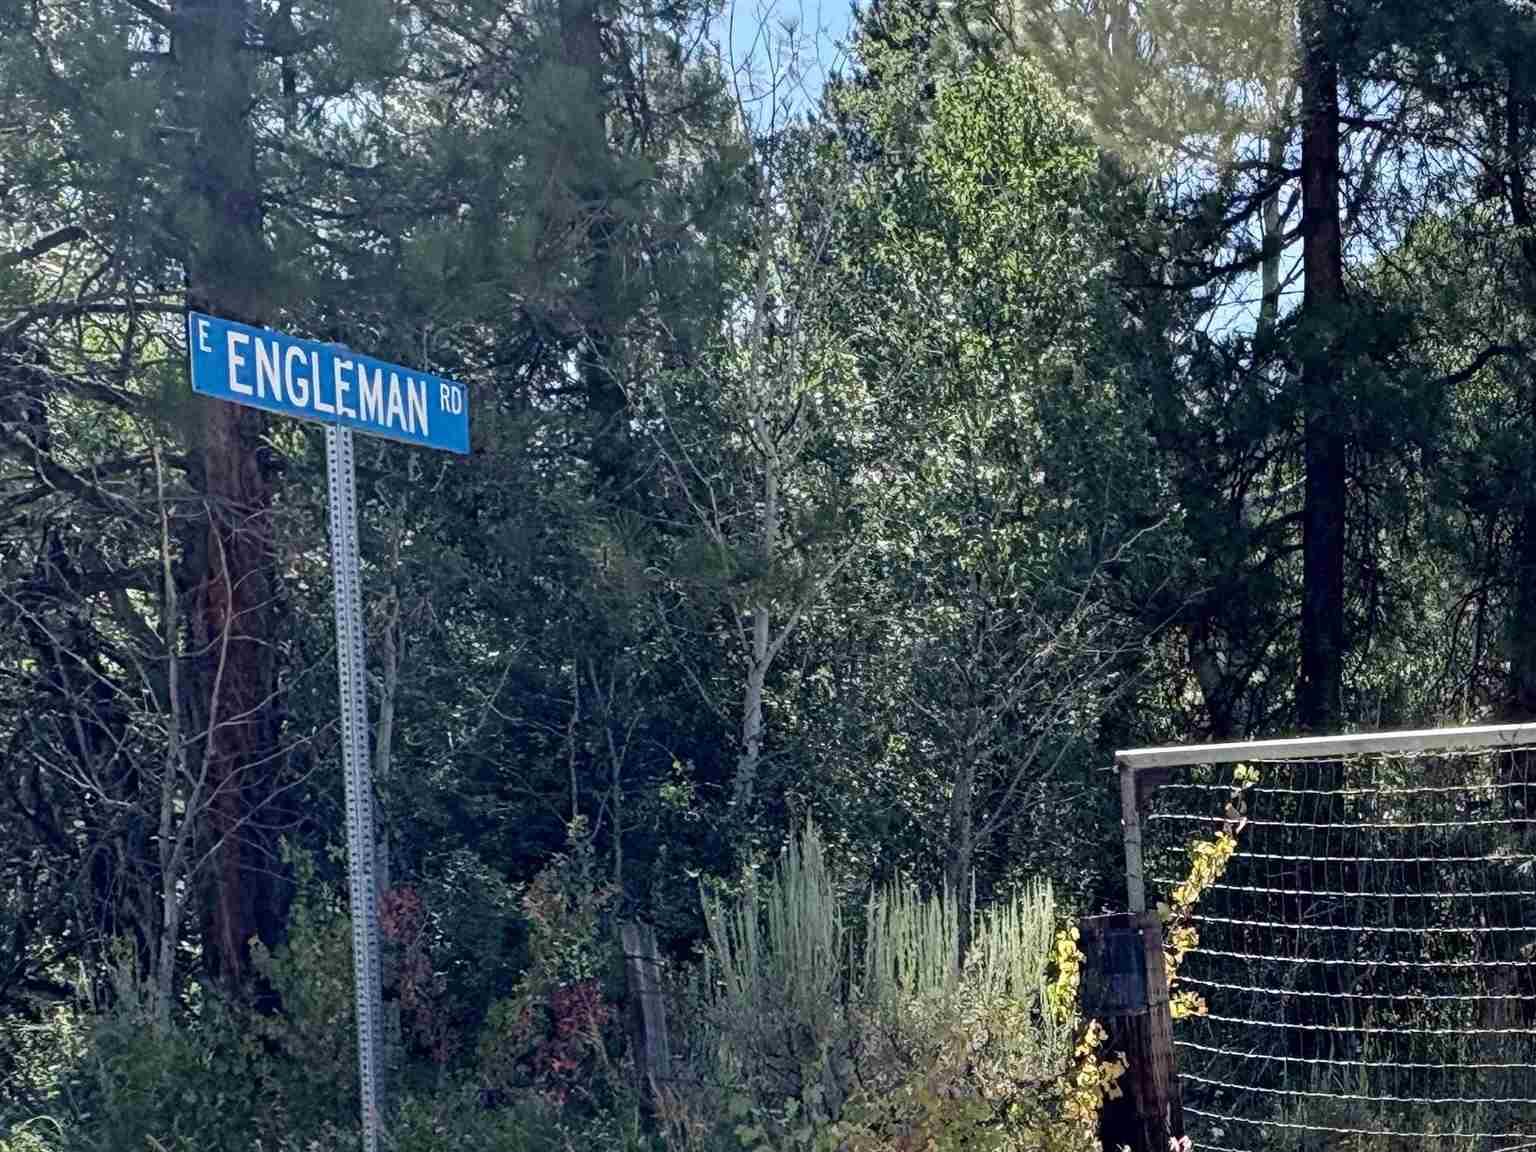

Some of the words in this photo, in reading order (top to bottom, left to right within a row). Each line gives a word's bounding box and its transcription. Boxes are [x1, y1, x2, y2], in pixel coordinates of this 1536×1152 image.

[198, 318, 212, 353] E
[226, 330, 429, 437] ENGLEMAN
[439, 382, 463, 416] RD
